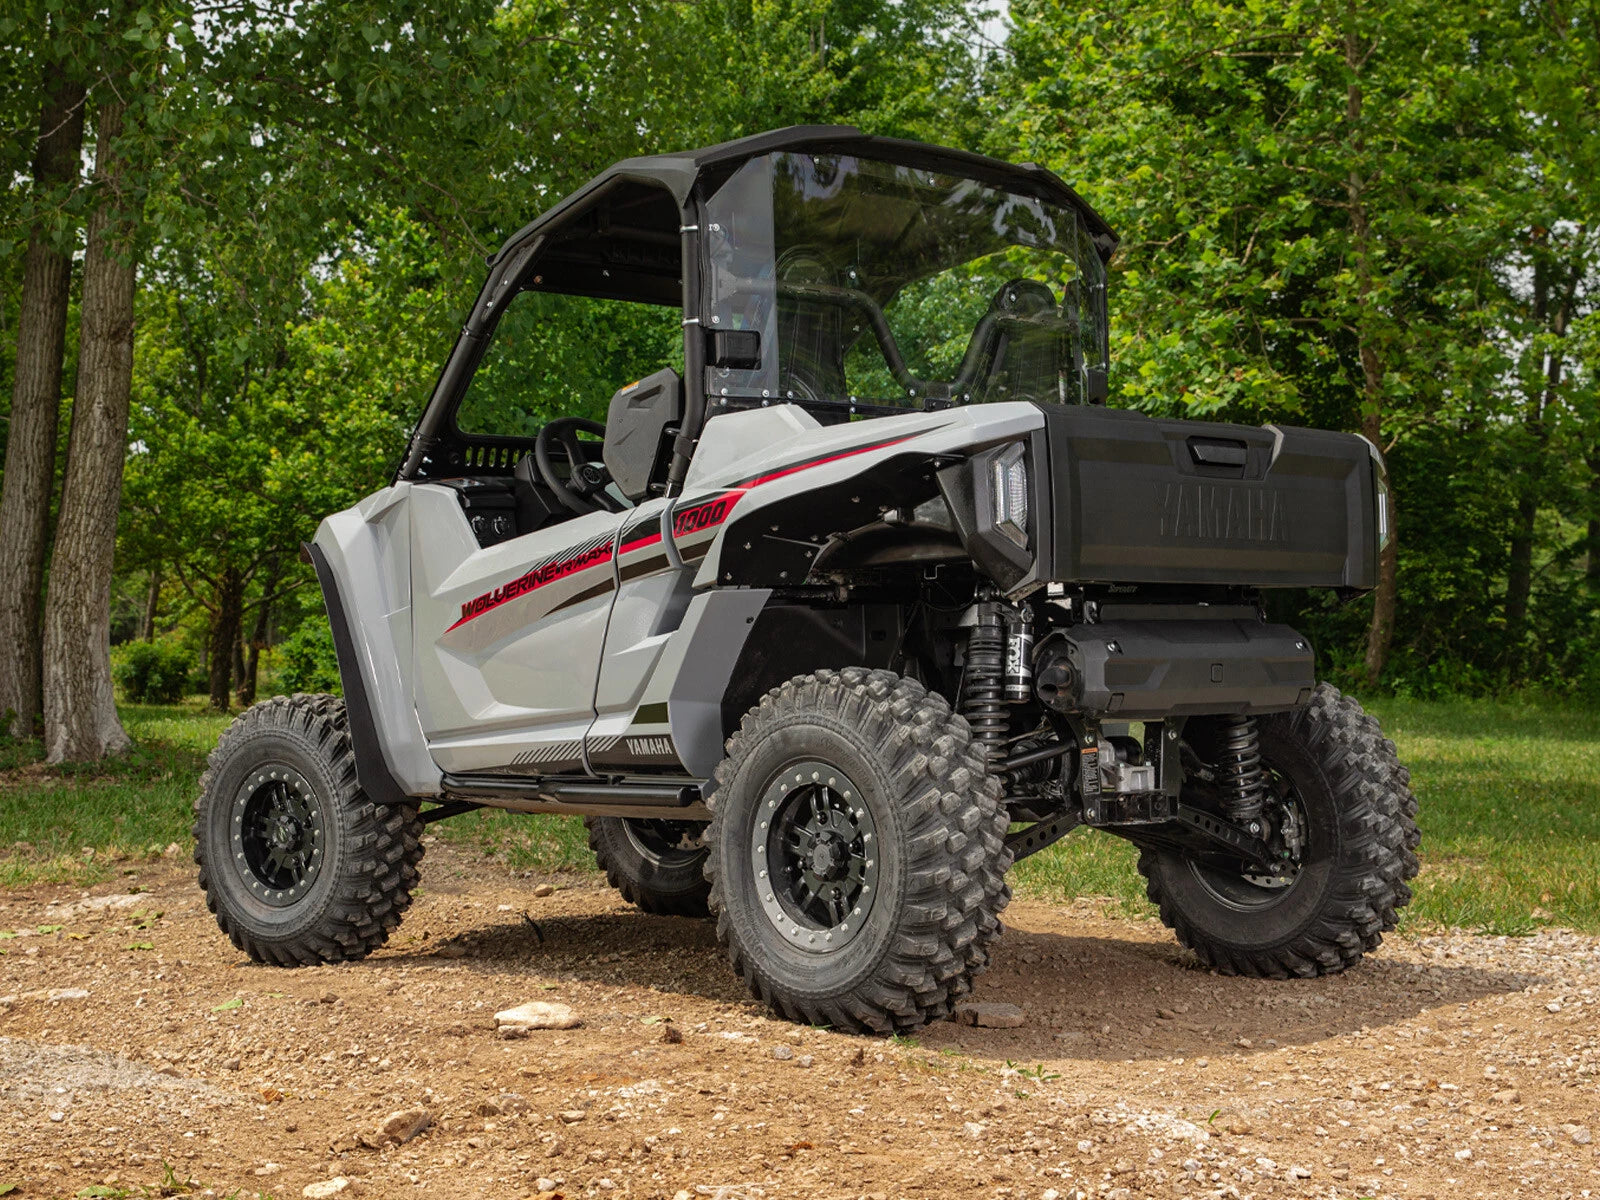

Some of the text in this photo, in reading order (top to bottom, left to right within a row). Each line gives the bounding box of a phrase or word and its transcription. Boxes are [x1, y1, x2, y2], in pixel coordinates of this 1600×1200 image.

[674, 501, 727, 536] 1000
[1153, 482, 1287, 541] YAMAHA
[461, 561, 558, 619] WOLVERINE
[1007, 637, 1021, 674] FOX
[626, 737, 674, 755] YAMAHA
